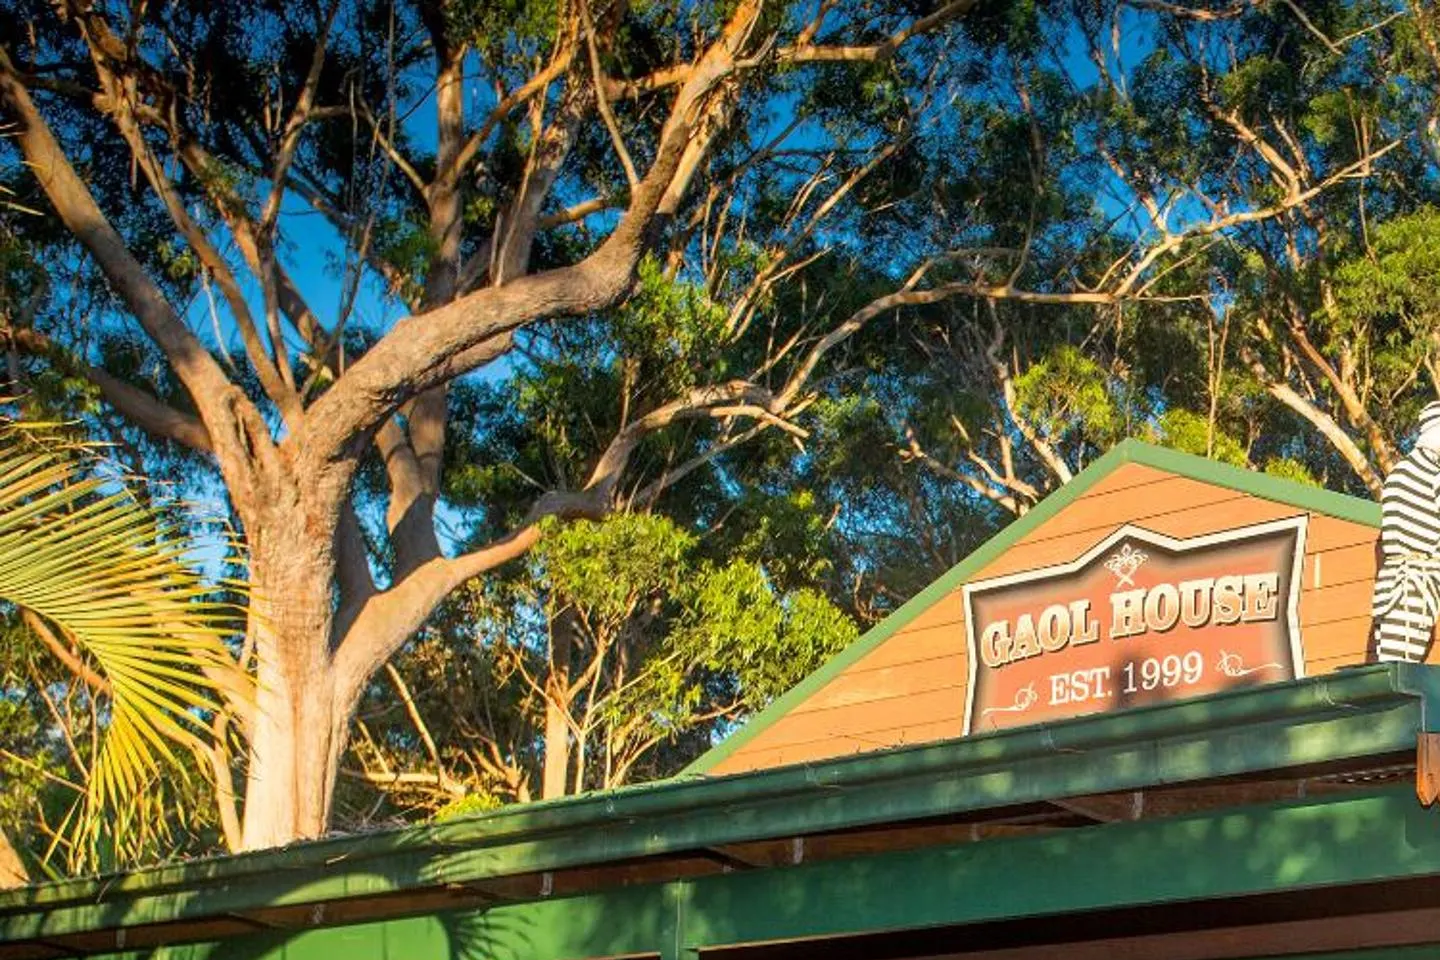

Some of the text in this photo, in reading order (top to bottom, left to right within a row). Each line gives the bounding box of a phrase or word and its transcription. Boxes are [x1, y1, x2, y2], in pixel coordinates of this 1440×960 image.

[981, 572, 1280, 669] GAOL HOUSE
[1049, 651, 1204, 706] EST. 1999
